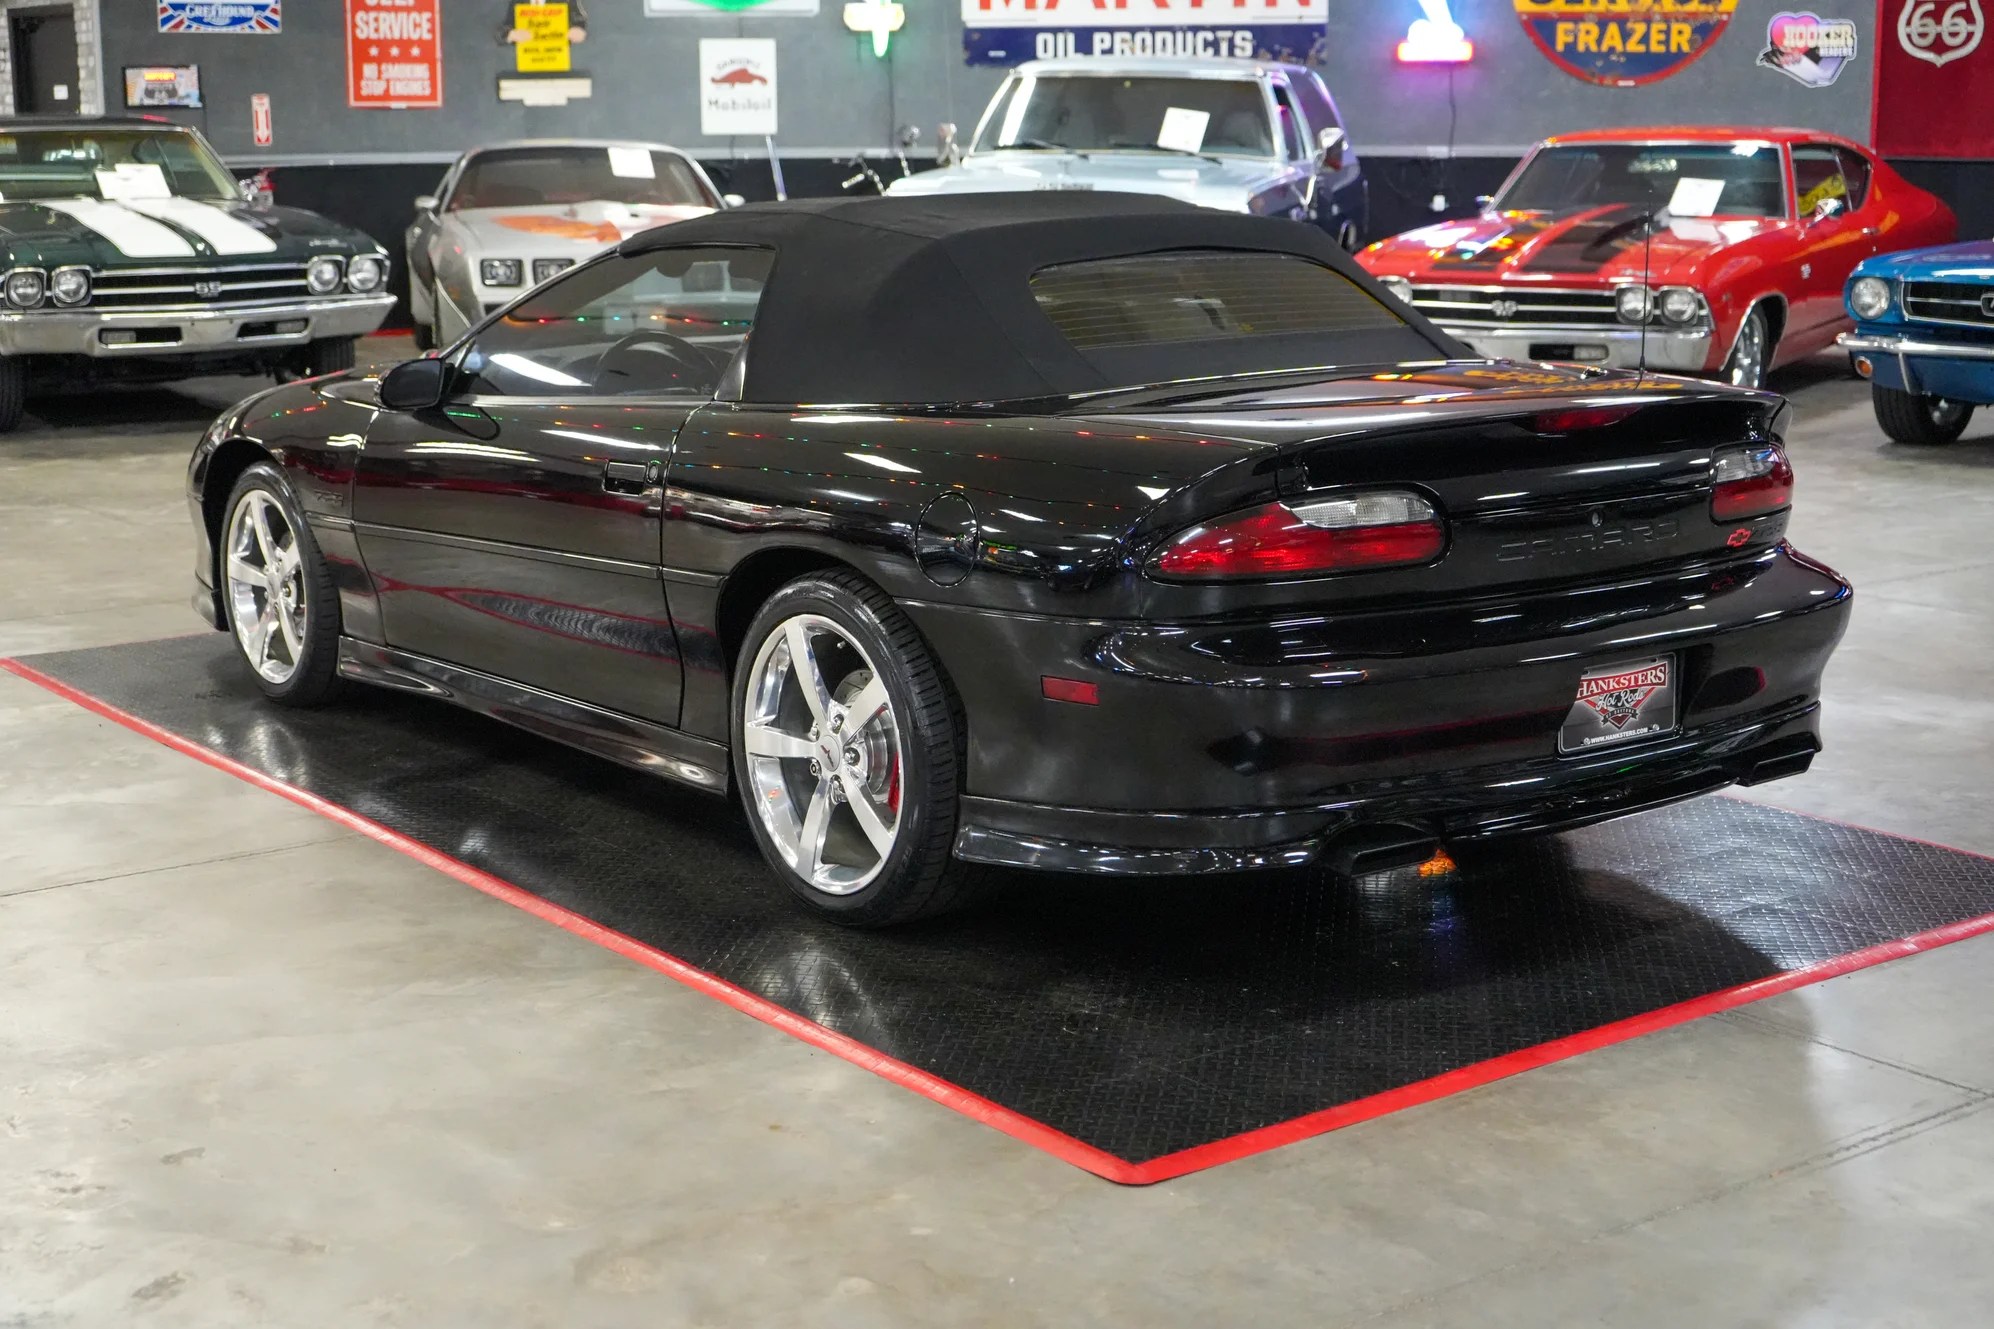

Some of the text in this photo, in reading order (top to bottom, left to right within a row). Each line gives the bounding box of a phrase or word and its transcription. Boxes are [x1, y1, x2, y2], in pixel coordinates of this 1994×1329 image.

[354, 10, 433, 40] SERVICE
[1555, 21, 1693, 53] FRAZER
[1783, 24, 1854, 48] HOOKER
[1910, 1, 1967, 47] 66
[1035, 30, 1254, 60] OIL PRODUCTS
[1496, 521, 1678, 562] CAMARO
[1576, 665, 1666, 699] HANKSTERS
[1595, 689, 1644, 711] Hot Rods
[1591, 727, 1648, 744] WWW.HANKSTERS.COM
